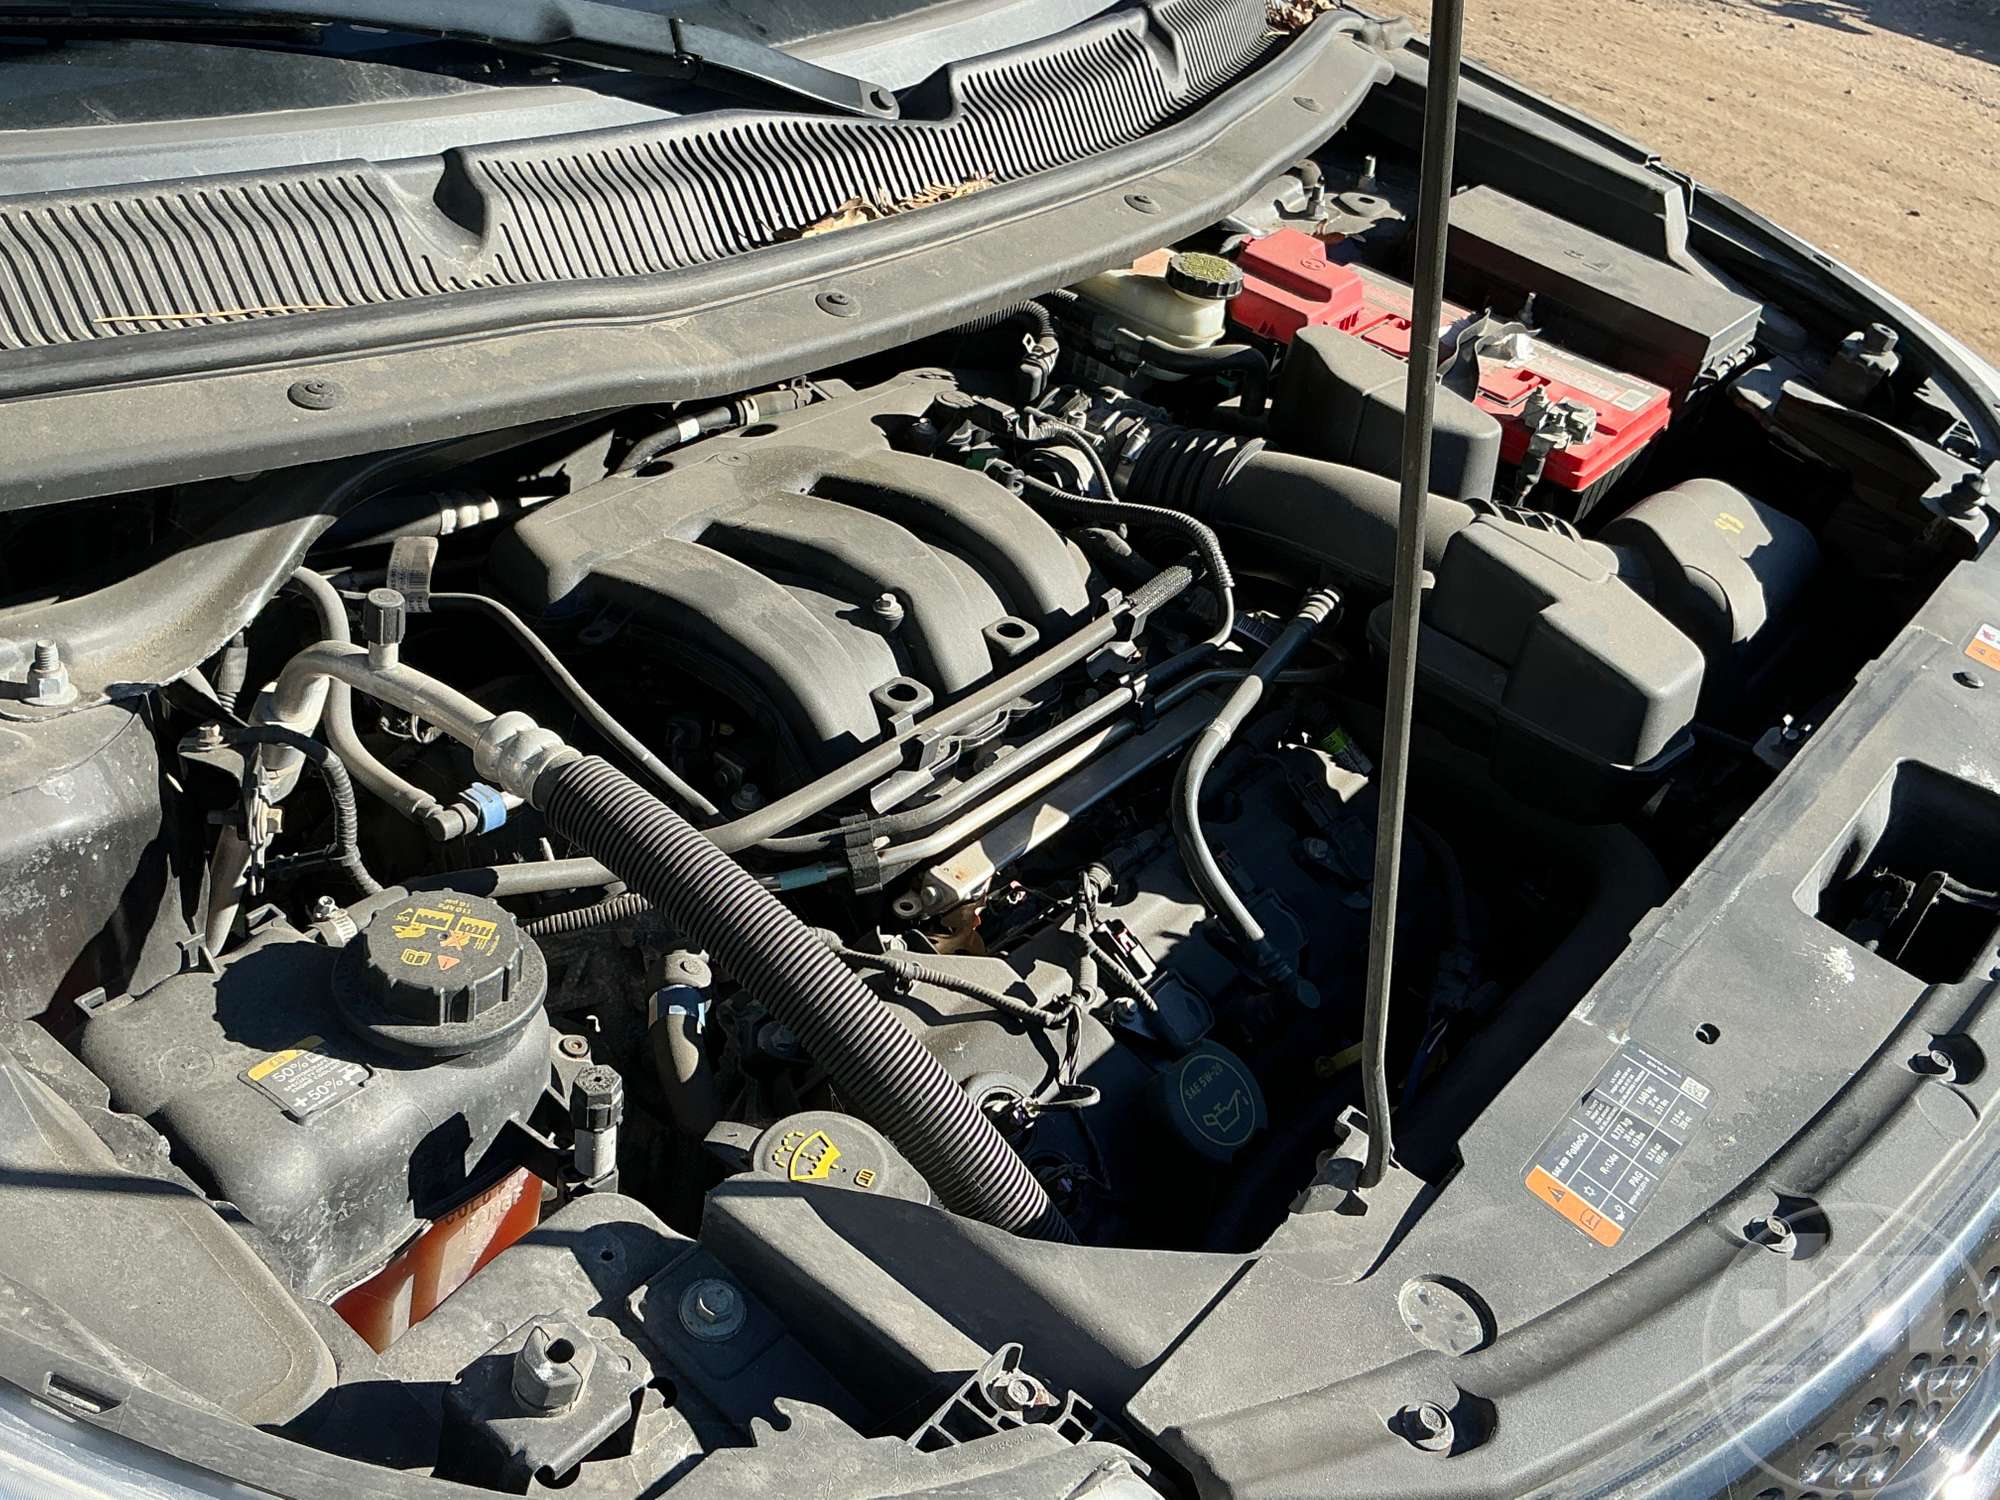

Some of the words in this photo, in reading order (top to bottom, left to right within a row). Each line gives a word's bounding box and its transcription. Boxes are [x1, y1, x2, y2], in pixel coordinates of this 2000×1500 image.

[272, 1061, 308, 1082] 50%
[1184, 1081, 1201, 1100] SAE
[1199, 1062, 1224, 1088] 5W-20
[307, 1077, 343, 1100] 50%
[1565, 1132, 1589, 1159] FoMoCo
[1600, 1153, 1619, 1175] R-134a
[1628, 1170, 1644, 1188] PAG
